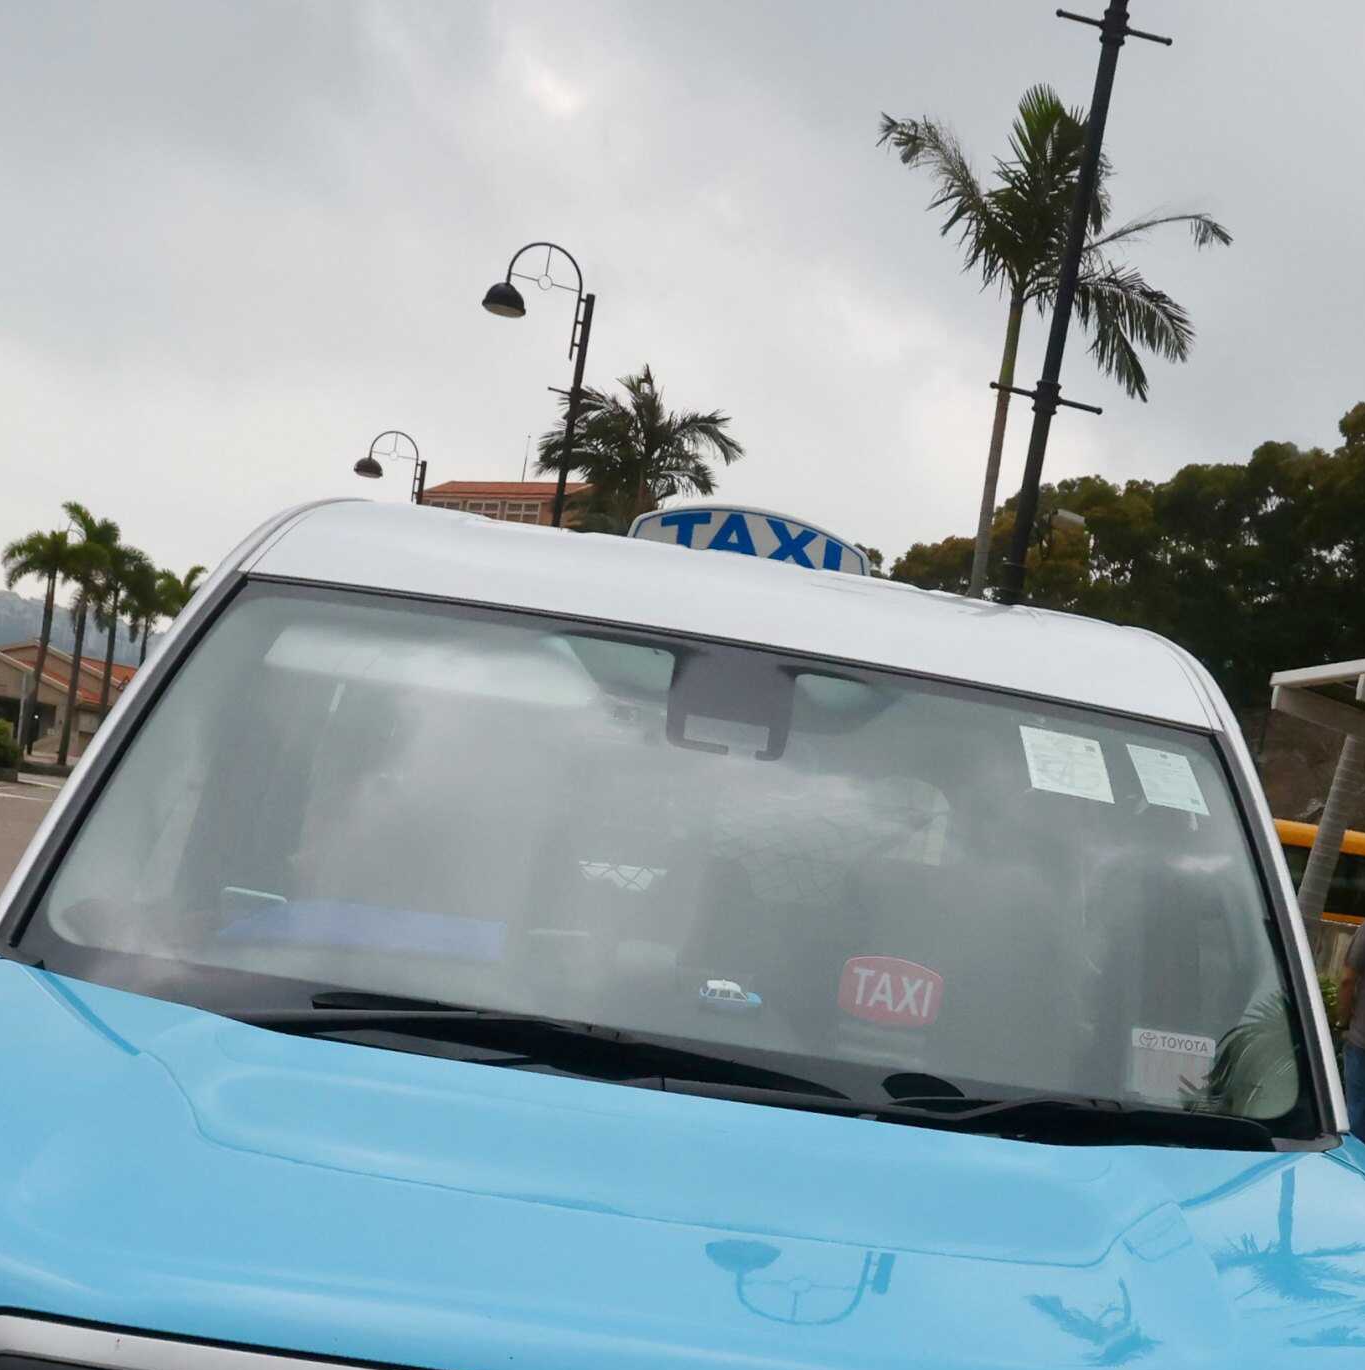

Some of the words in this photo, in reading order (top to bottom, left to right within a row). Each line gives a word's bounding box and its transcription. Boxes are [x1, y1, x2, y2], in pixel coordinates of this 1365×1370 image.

[661, 512, 844, 571] TAXI
[853, 966, 934, 1018] TAXI
[1160, 1036, 1208, 1052] TOYOTA
